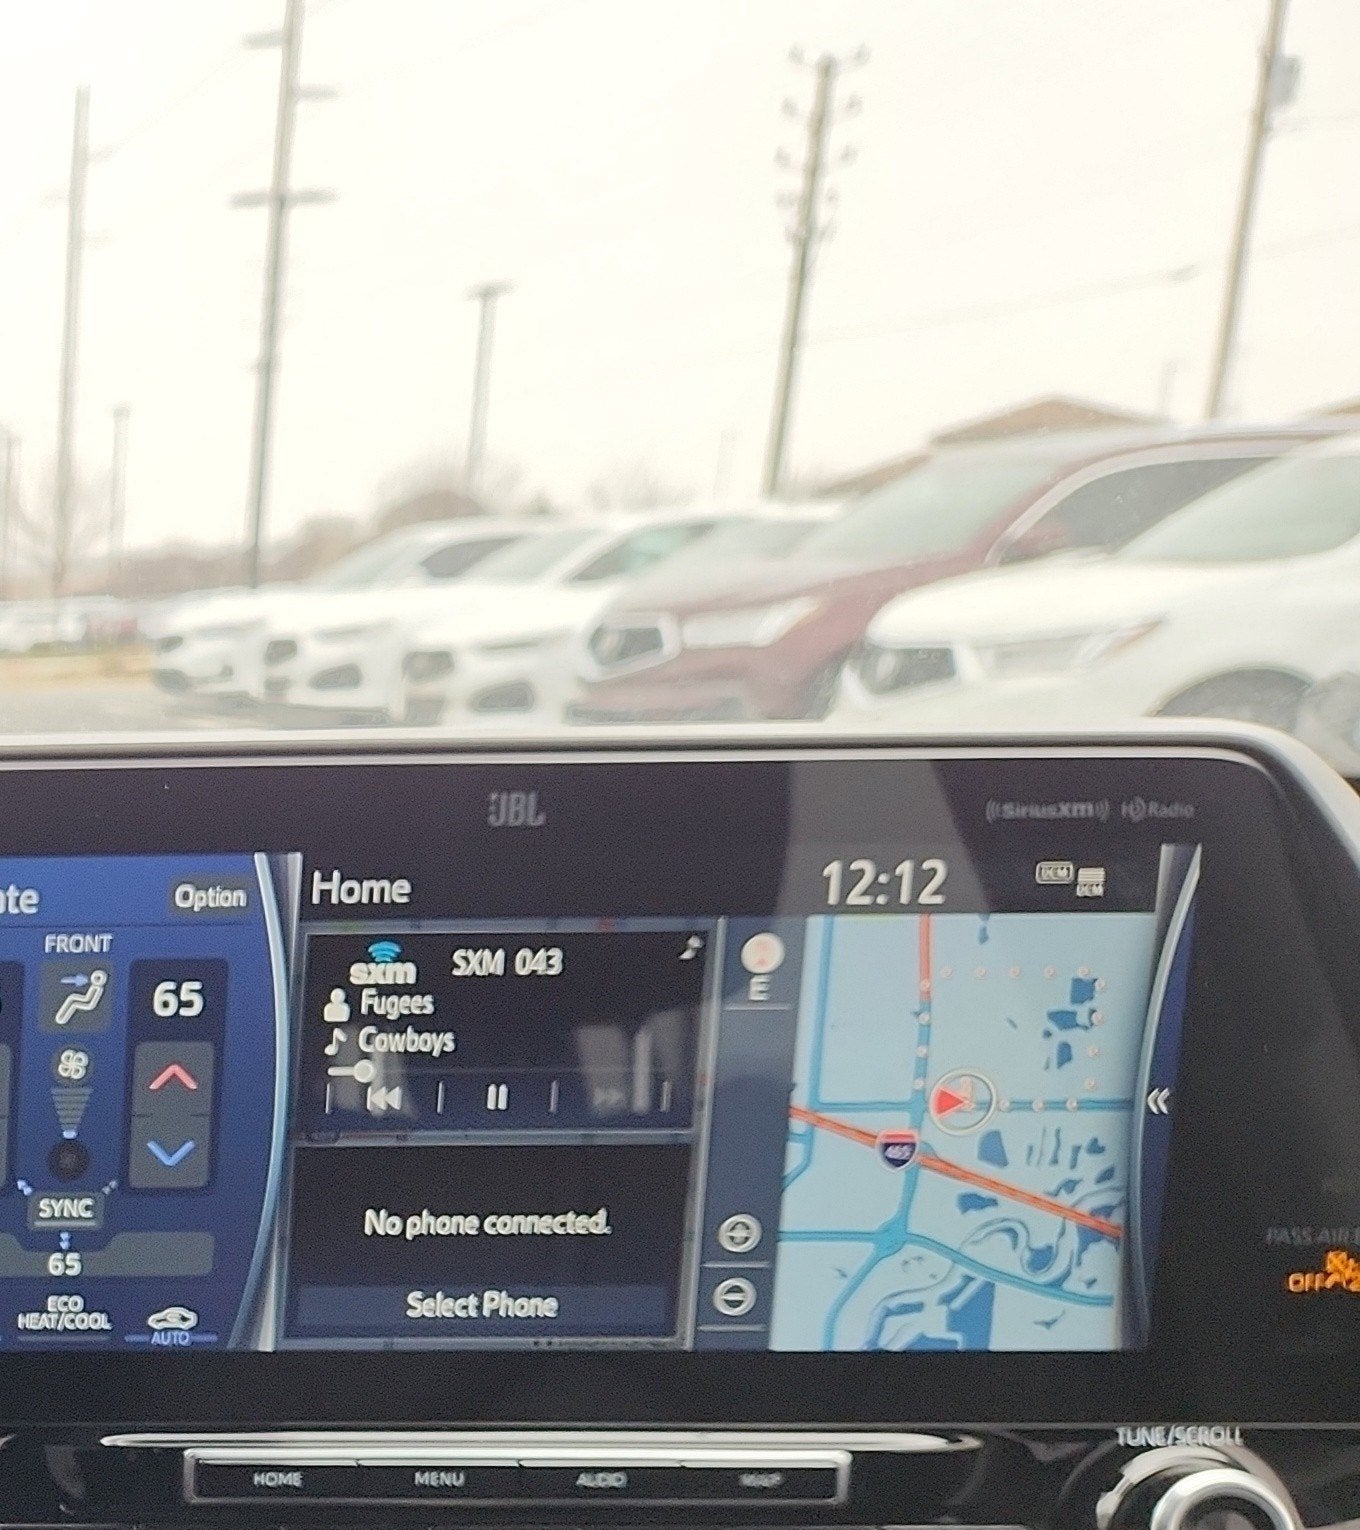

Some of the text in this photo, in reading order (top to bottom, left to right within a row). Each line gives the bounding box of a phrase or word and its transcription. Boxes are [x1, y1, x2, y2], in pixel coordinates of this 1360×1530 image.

[486, 791, 547, 829] JBL
[311, 871, 412, 905] Home
[821, 858, 949, 907] 12:12
[174, 883, 247, 912] Option
[44, 934, 112, 954] FRONT
[349, 961, 417, 985] sxm
[452, 947, 564, 977] SXM 043
[152, 981, 204, 1018] 65
[361, 988, 434, 1020] Fugees
[359, 1026, 455, 1058] Cowboys
[38, 1198, 94, 1218] SYNC
[364, 1207, 613, 1240] No phone connected.
[47, 1252, 82, 1276] 65
[1288, 1272, 1324, 1292] OFF
[47, 1295, 84, 1313] ECO
[406, 1290, 559, 1318] Select Phone
[17, 1312, 112, 1331] HEAT/COOL
[151, 1331, 190, 1346] AUTO
[1116, 1426, 1244, 1448] TUNE/SCROLL
[253, 1471, 304, 1487] HOME
[414, 1471, 465, 1488] MENU
